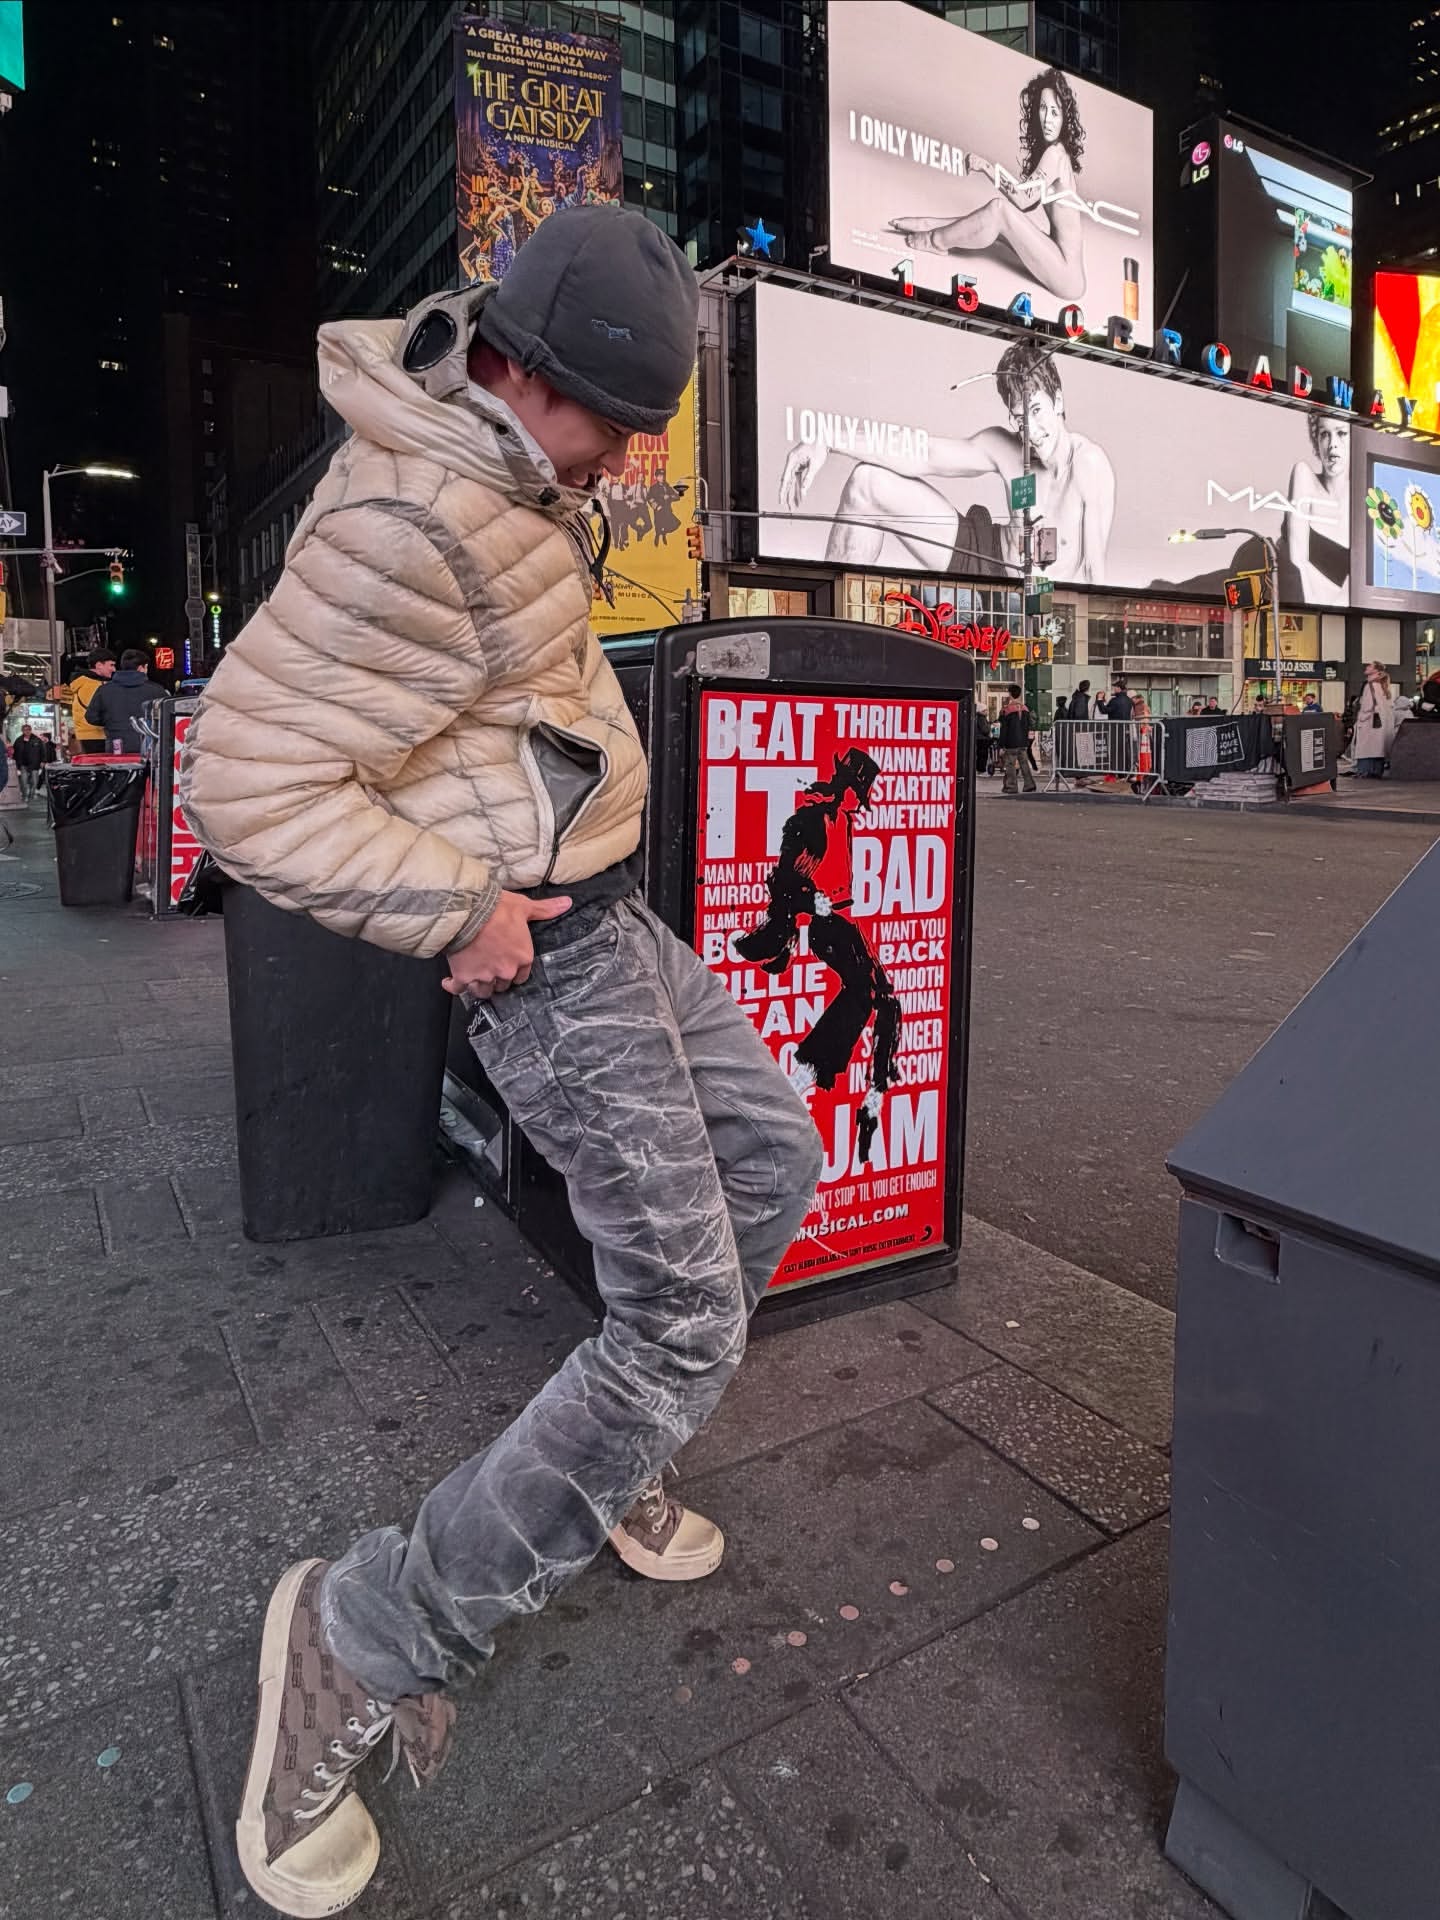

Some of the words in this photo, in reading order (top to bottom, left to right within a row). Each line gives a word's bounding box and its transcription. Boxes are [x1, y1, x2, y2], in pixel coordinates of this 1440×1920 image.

[478, 28, 520, 45] GREAT,
[522, 36, 543, 49] BIG
[544, 40, 608, 62] BROADWAY
[493, 41, 584, 69] EXTRAVAGANZA
[466, 49, 486, 59] THAT
[486, 52, 525, 66] EXPLODES
[526, 60, 545, 70] WITH
[546, 63, 561, 73] LIFE
[562, 67, 578, 77] AND
[469, 68, 515, 102] THE
[521, 78, 606, 118] GREAT
[486, 102, 592, 143] GATSBY
[505, 133, 512, 141] A
[514, 135, 535, 144] NEW
[536, 138, 576, 151] MUSICAL
[849, 110, 857, 141] I
[860, 115, 907, 158] ONLY
[911, 131, 965, 177] WEAR
[1232, 138, 1244, 153] LG
[1192, 165, 1210, 184] LG
[785, 406, 794, 441] I
[800, 409, 859, 450] ONLY
[863, 419, 929, 463] WEAR
[0, 519, 14, 528] AY
[706, 698, 823, 761] BEAT
[834, 703, 952, 740] THRILLER
[868, 746, 927, 773] WANNA
[930, 747, 950, 773] BE
[705, 766, 818, 859] IT
[704, 863, 735, 885] MAN
[738, 862, 752, 883] IN
[756, 861, 779, 883] TH
[850, 835, 947, 917] BAD
[703, 912, 741, 931] BLAME
[743, 911, 754, 928] IT
[872, 921, 877, 943] I
[880, 919, 918, 942] WANT
[920, 917, 946, 939] YOU
[879, 940, 945, 965] BACK
[885, 965, 945, 991] SMOOTH
[849, 1061, 867, 1094] IN
[819, 1090, 939, 1183] JAM
[834, 1185, 856, 1208] STOP
[872, 1178, 889, 1199] YOU
[889, 1174, 904, 1197] GET
[906, 1168, 937, 1192] ENOUGH
